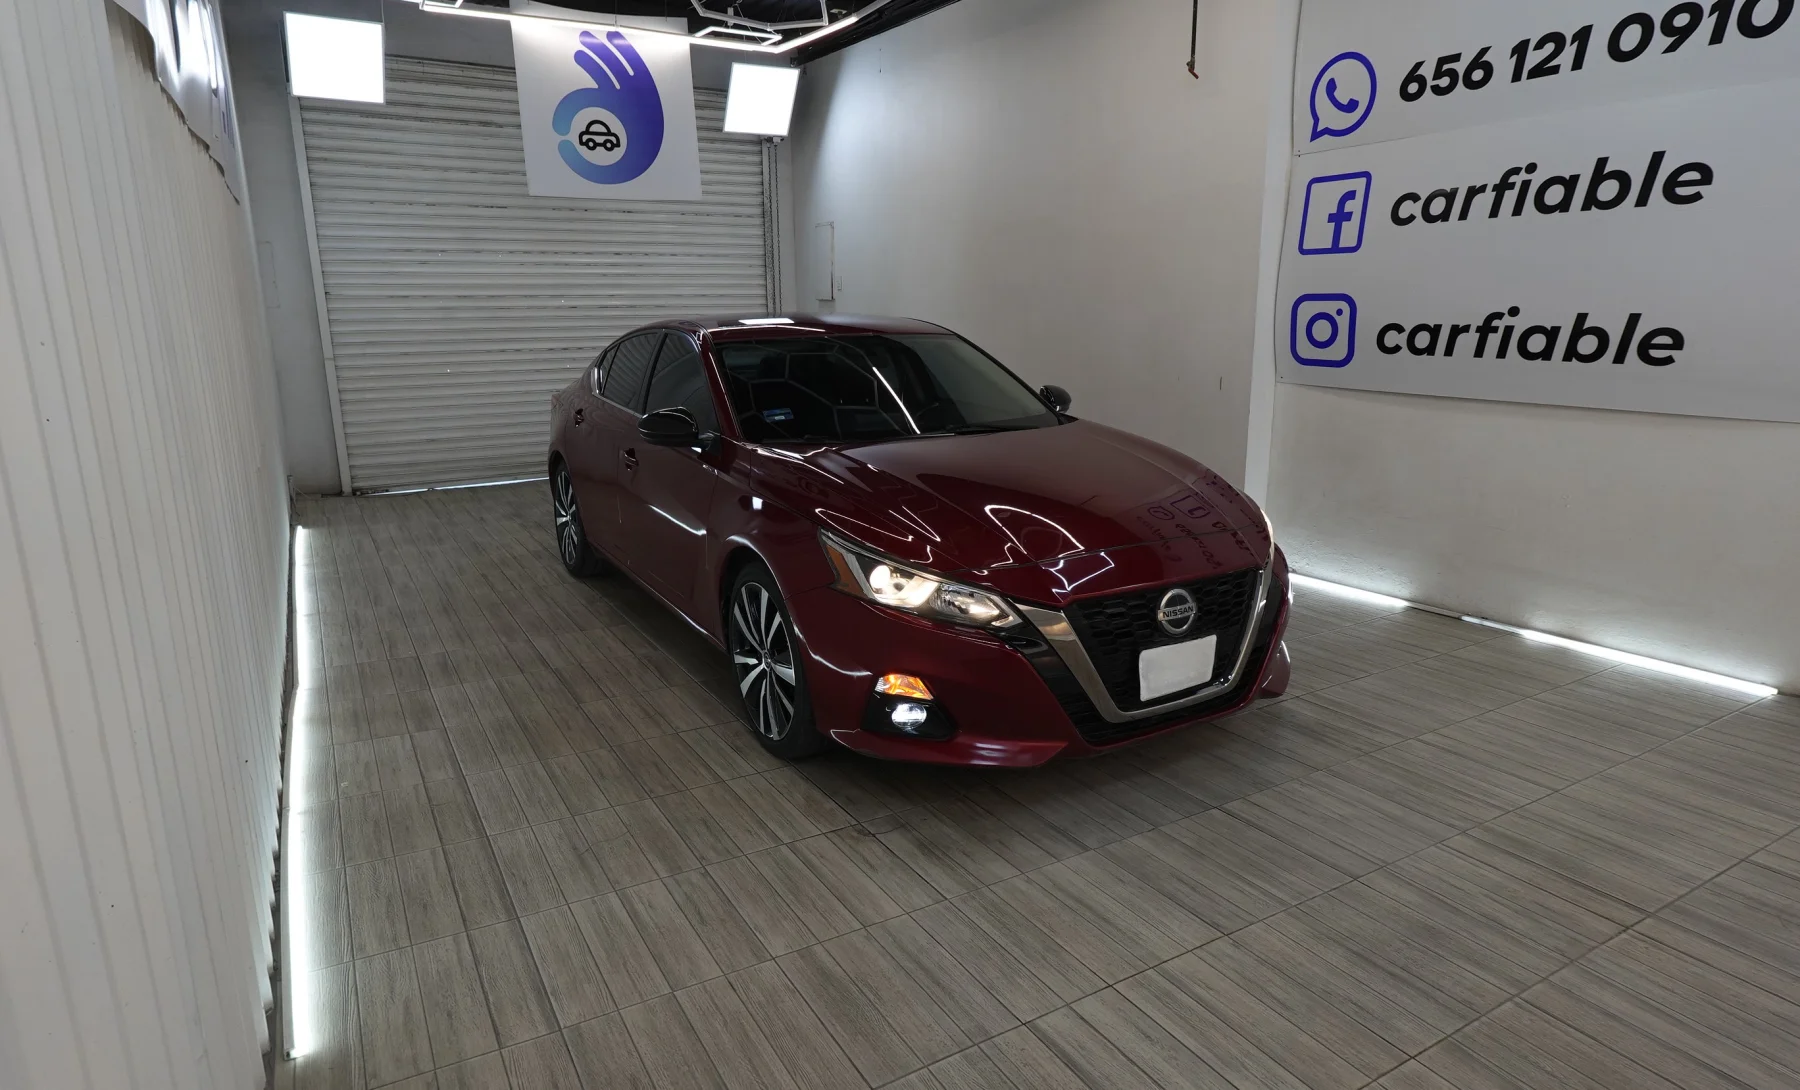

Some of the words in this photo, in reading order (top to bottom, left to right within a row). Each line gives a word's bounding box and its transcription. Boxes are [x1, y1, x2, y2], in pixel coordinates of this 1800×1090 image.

[1399, 46, 1494, 103] 656
[1509, 24, 1594, 83] 121
[1607, 0, 1795, 63] 0910
[1390, 150, 1714, 227] carfiable
[1376, 306, 1685, 367] carfiable
[1162, 605, 1194, 618] NISSAN
